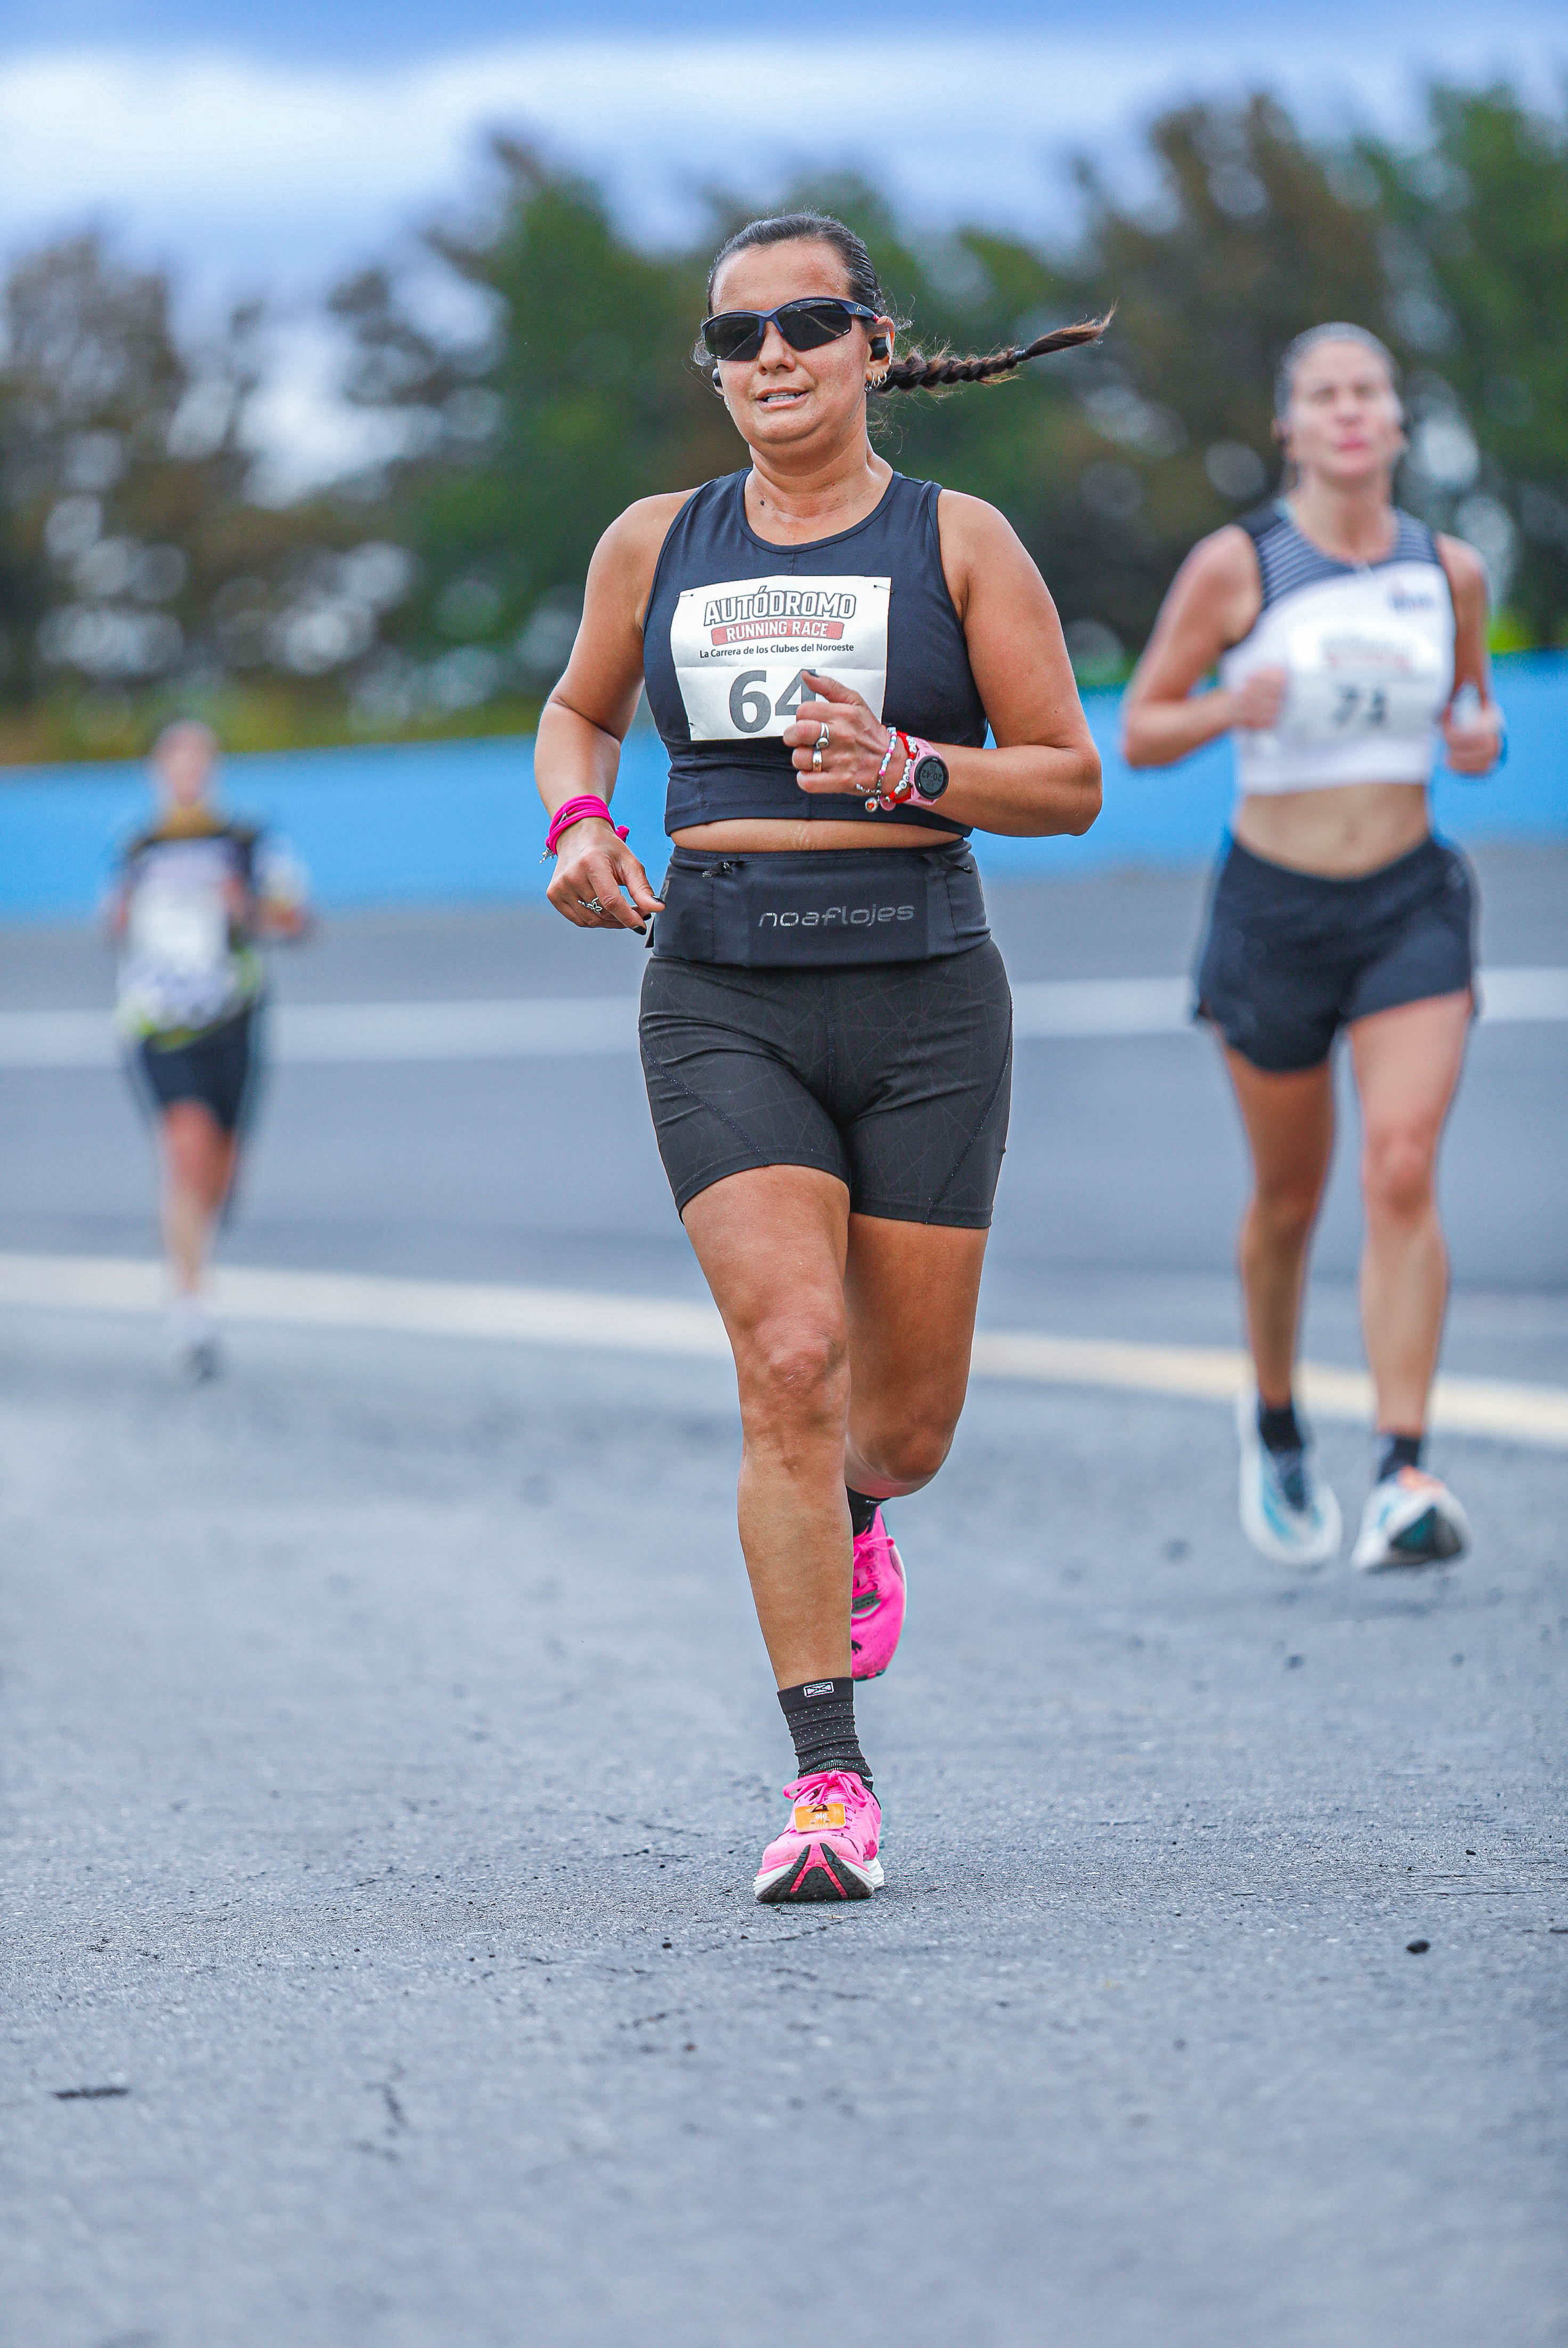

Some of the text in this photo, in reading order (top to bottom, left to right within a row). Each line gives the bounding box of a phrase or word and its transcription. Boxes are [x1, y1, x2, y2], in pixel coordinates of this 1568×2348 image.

[703, 586, 856, 627] AUTÓDROMO
[726, 621, 829, 643] RUNNING RACE
[700, 650, 709, 659] La
[711, 645, 741, 657] Carrera
[744, 646, 754, 654] de
[770, 644, 799, 653] Clubes
[801, 643, 814, 652] del
[729, 669, 817, 733] 64
[758, 904, 915, 927] noaflojes
